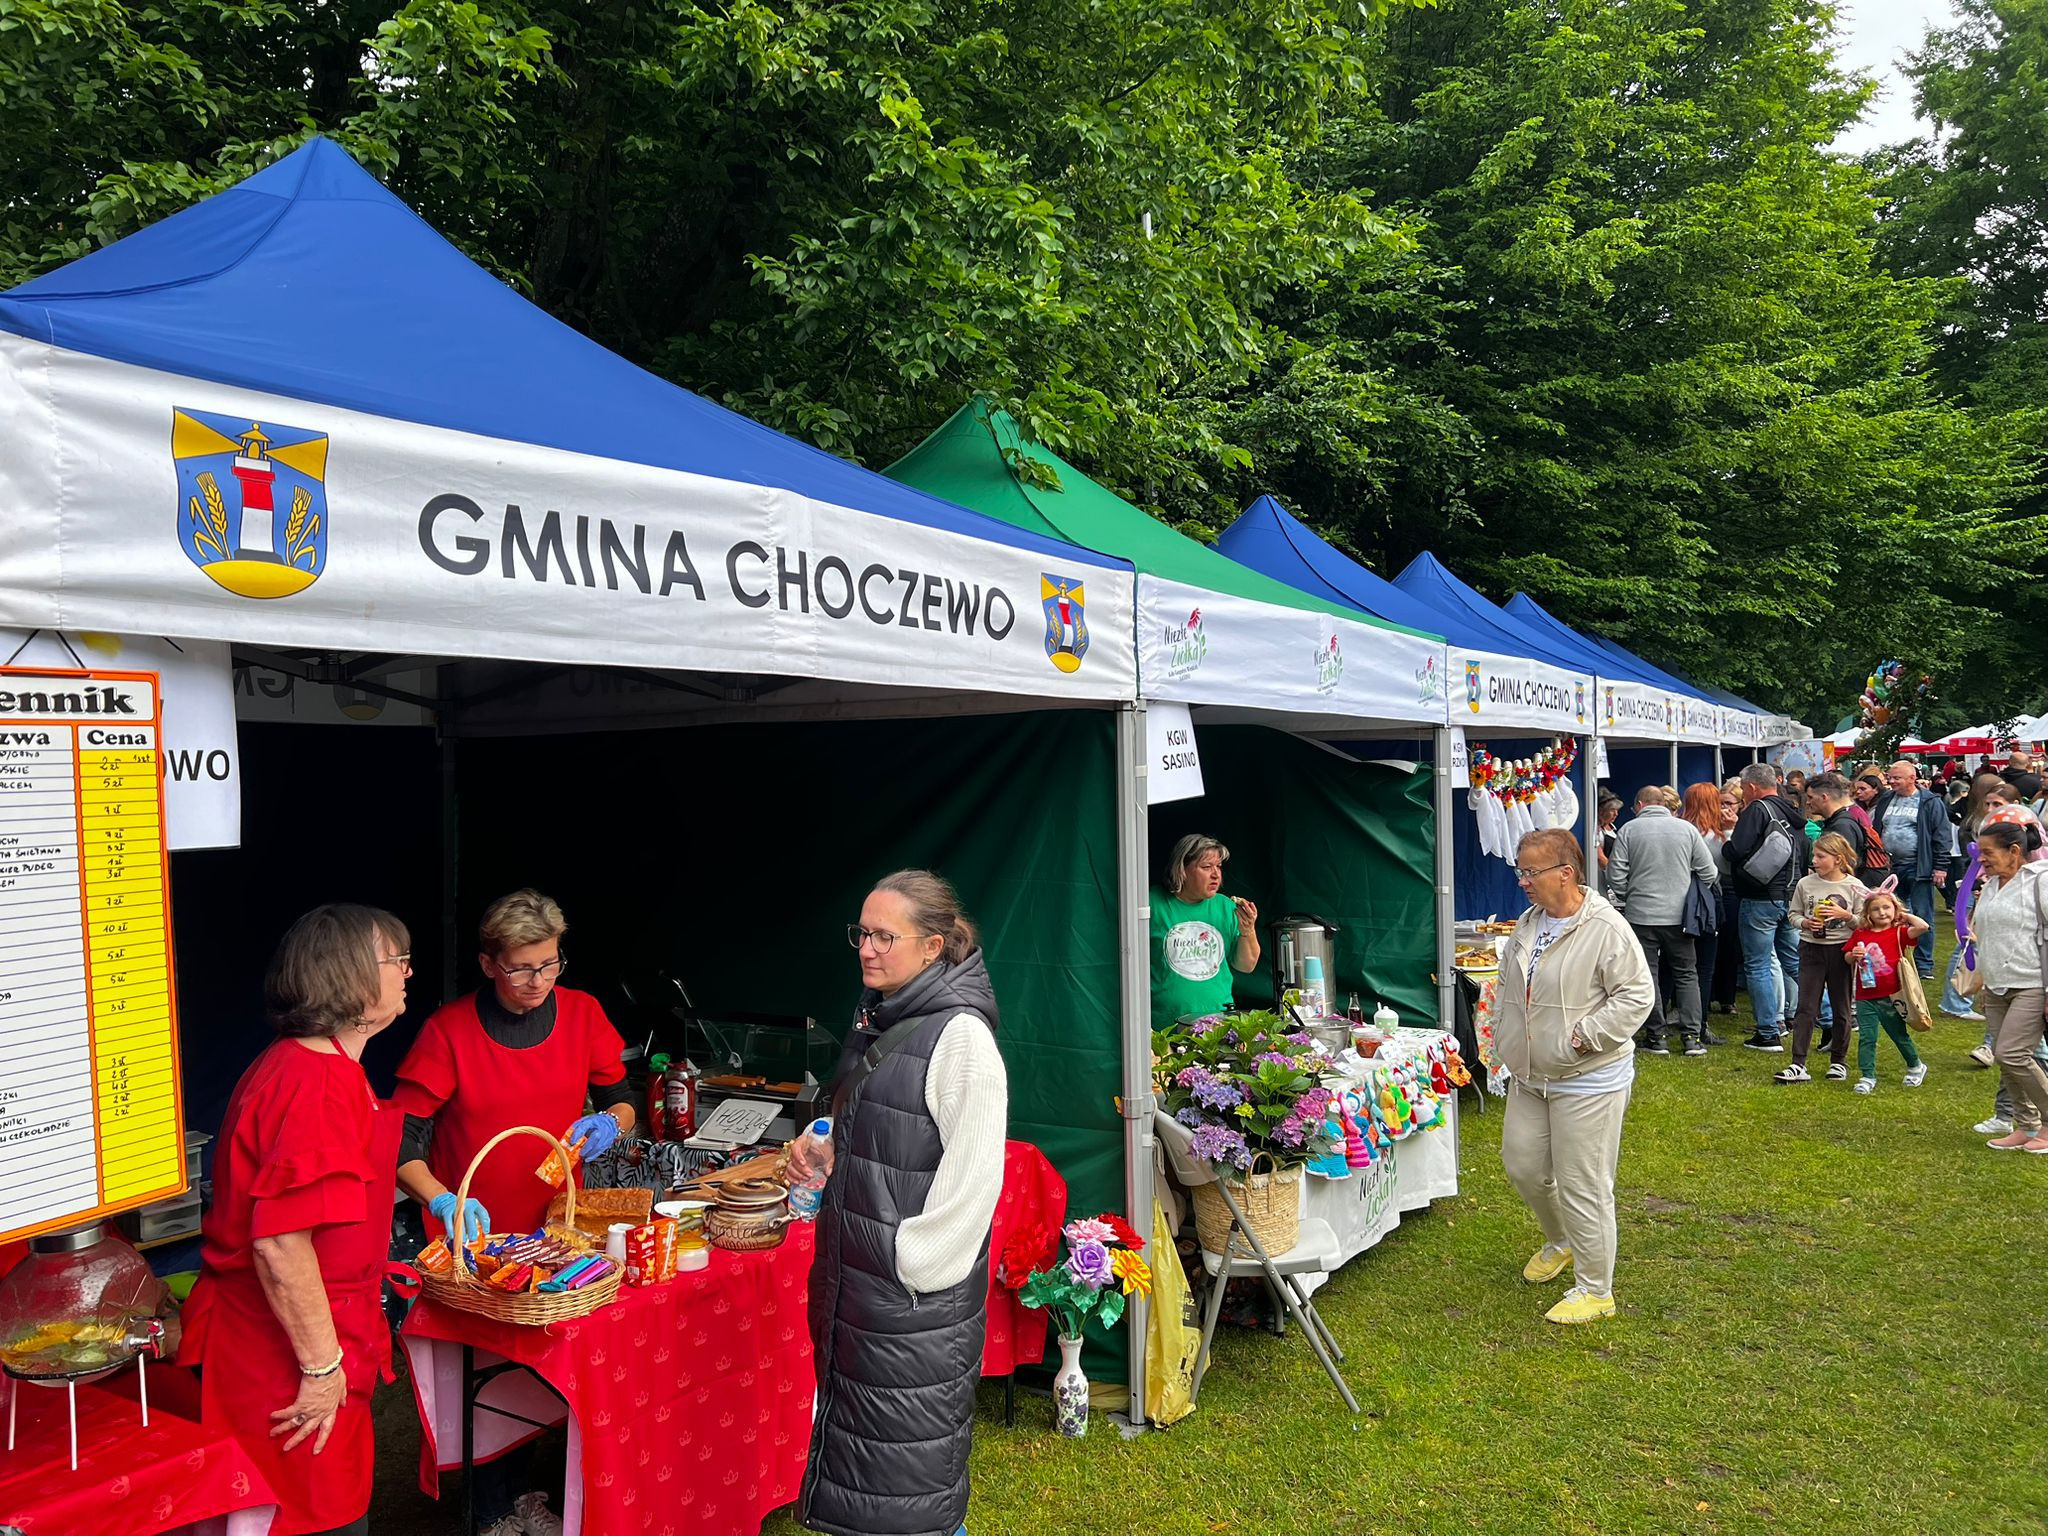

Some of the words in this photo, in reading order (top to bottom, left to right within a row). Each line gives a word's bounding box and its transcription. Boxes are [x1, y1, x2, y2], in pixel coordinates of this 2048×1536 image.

[418, 493, 706, 600] GMINA
[726, 540, 1015, 641] CHOCZEWO
[1164, 622, 1187, 645] Niezłe
[1489, 675, 1522, 704] GMINA
[1524, 680, 1570, 712] CHOCZEWO
[87, 730, 147, 745] Cena
[1166, 729, 1188, 746] KGW
[162, 749, 230, 781] WO
[1162, 752, 1196, 770] SASINO
